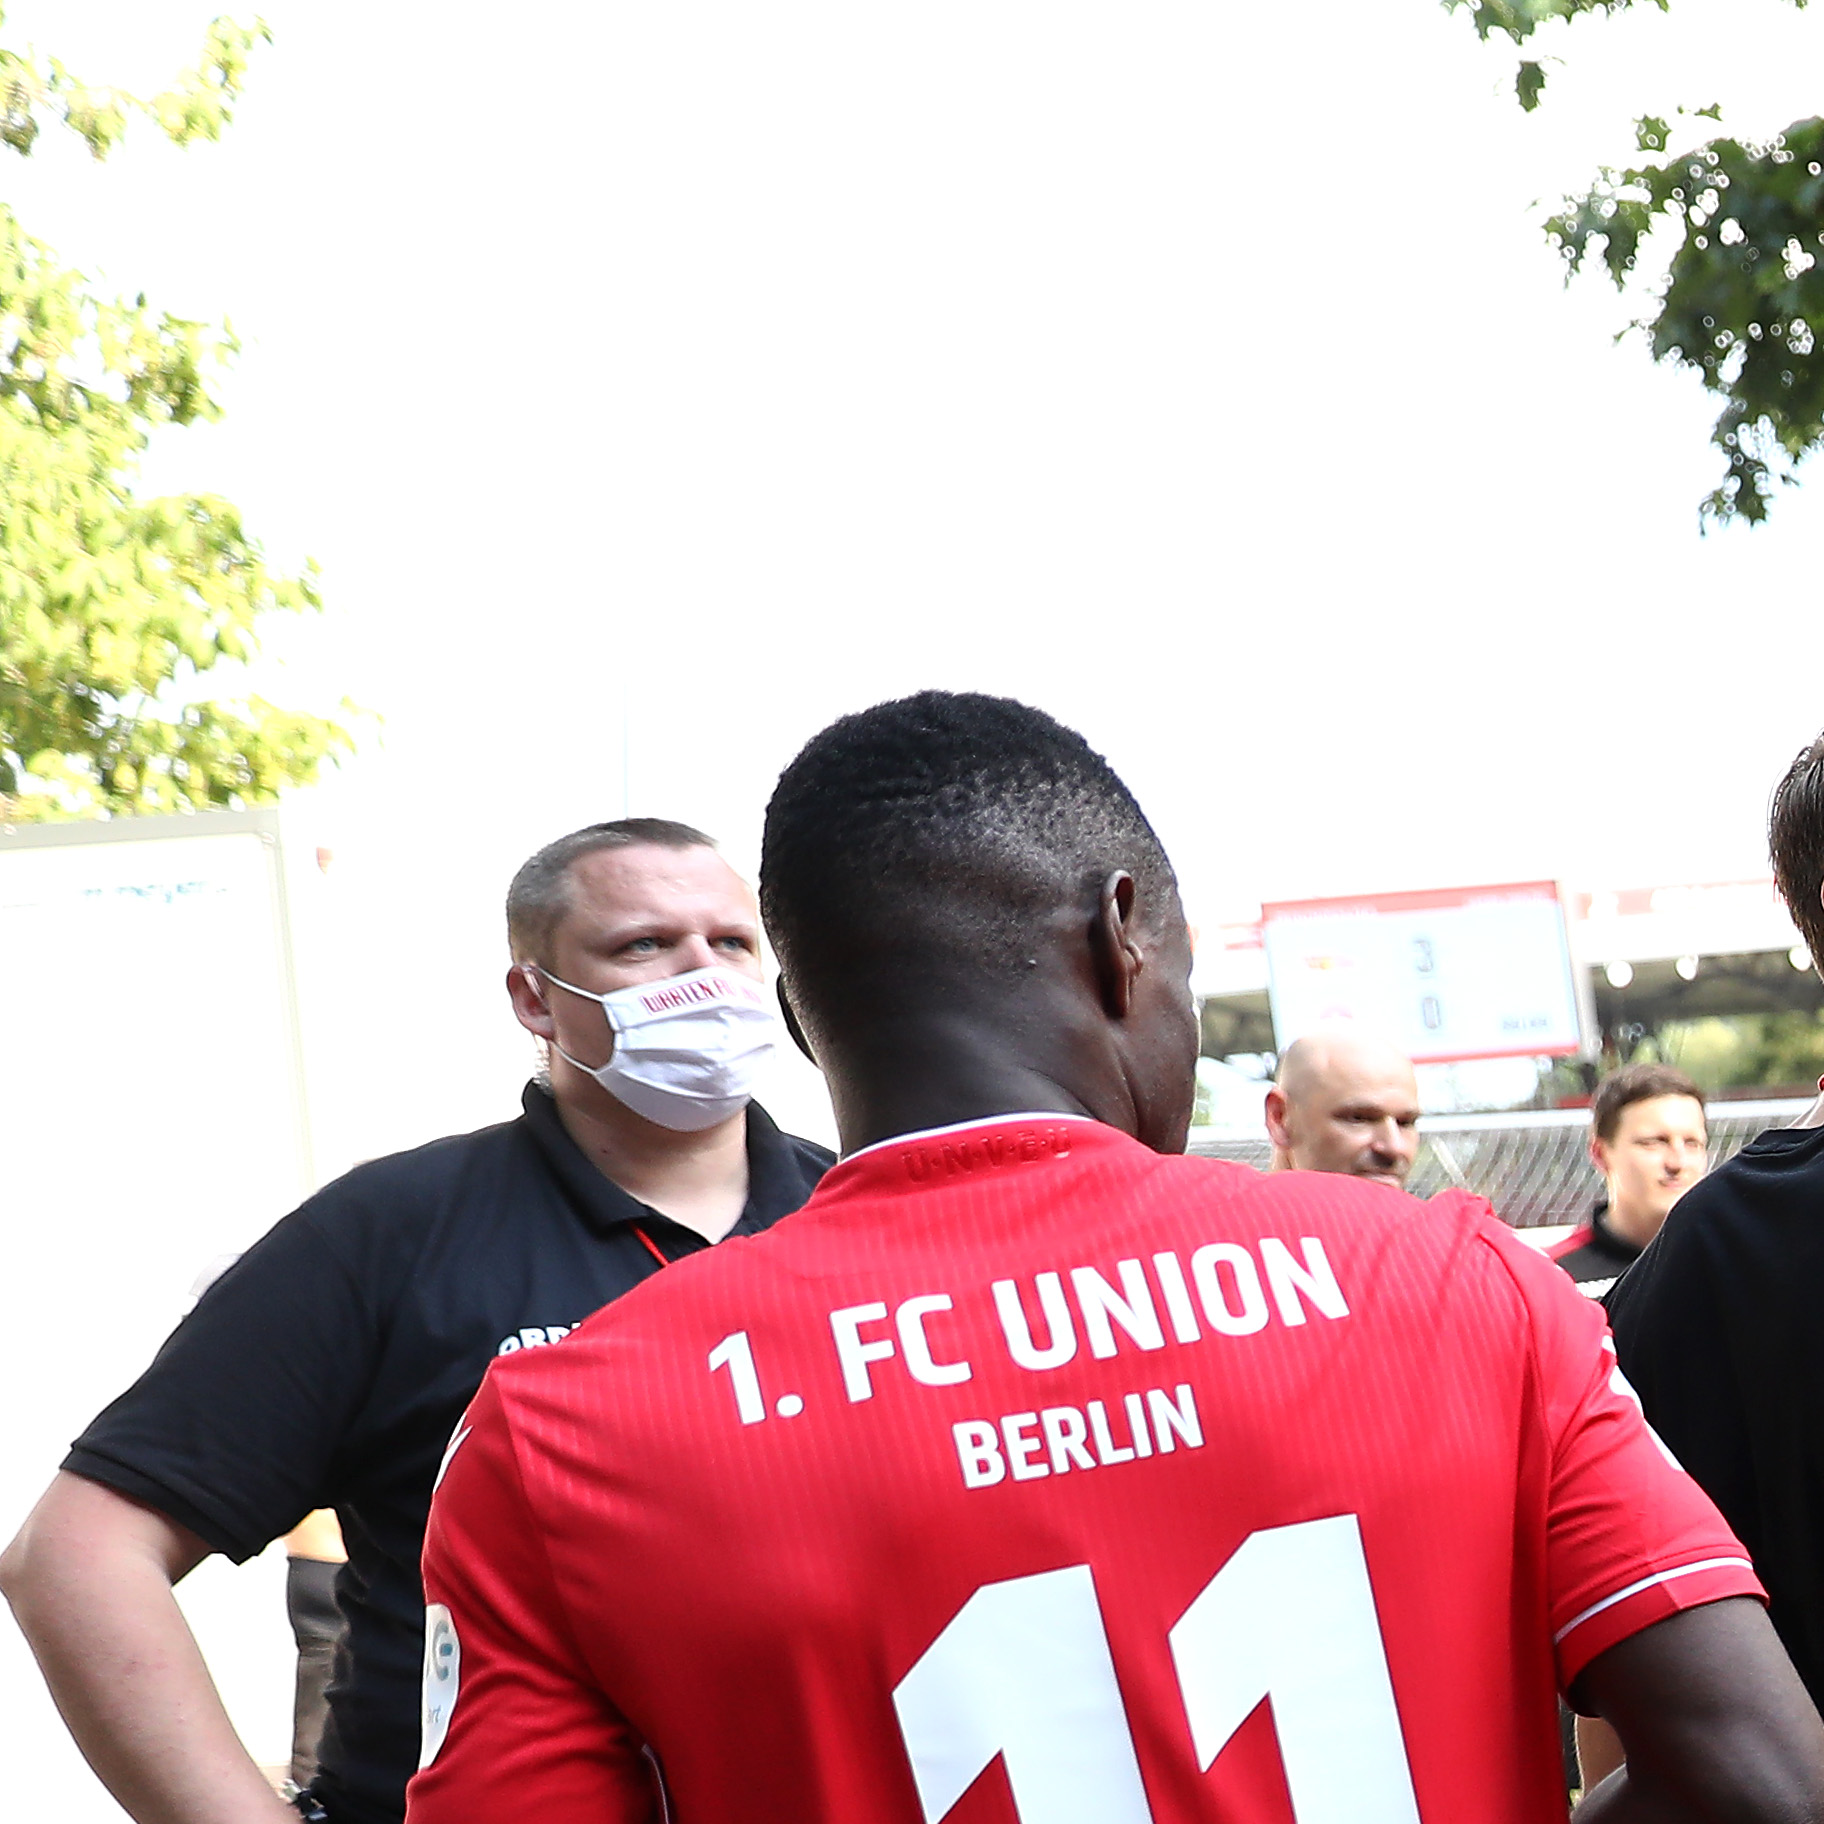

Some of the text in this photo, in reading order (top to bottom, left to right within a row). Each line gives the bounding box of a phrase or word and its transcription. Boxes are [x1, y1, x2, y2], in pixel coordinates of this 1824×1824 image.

[499, 1322, 581, 1356] ORD
[708, 1236, 1350, 1425] 1. FC UNION
[951, 1383, 1205, 1489] BERLIN
